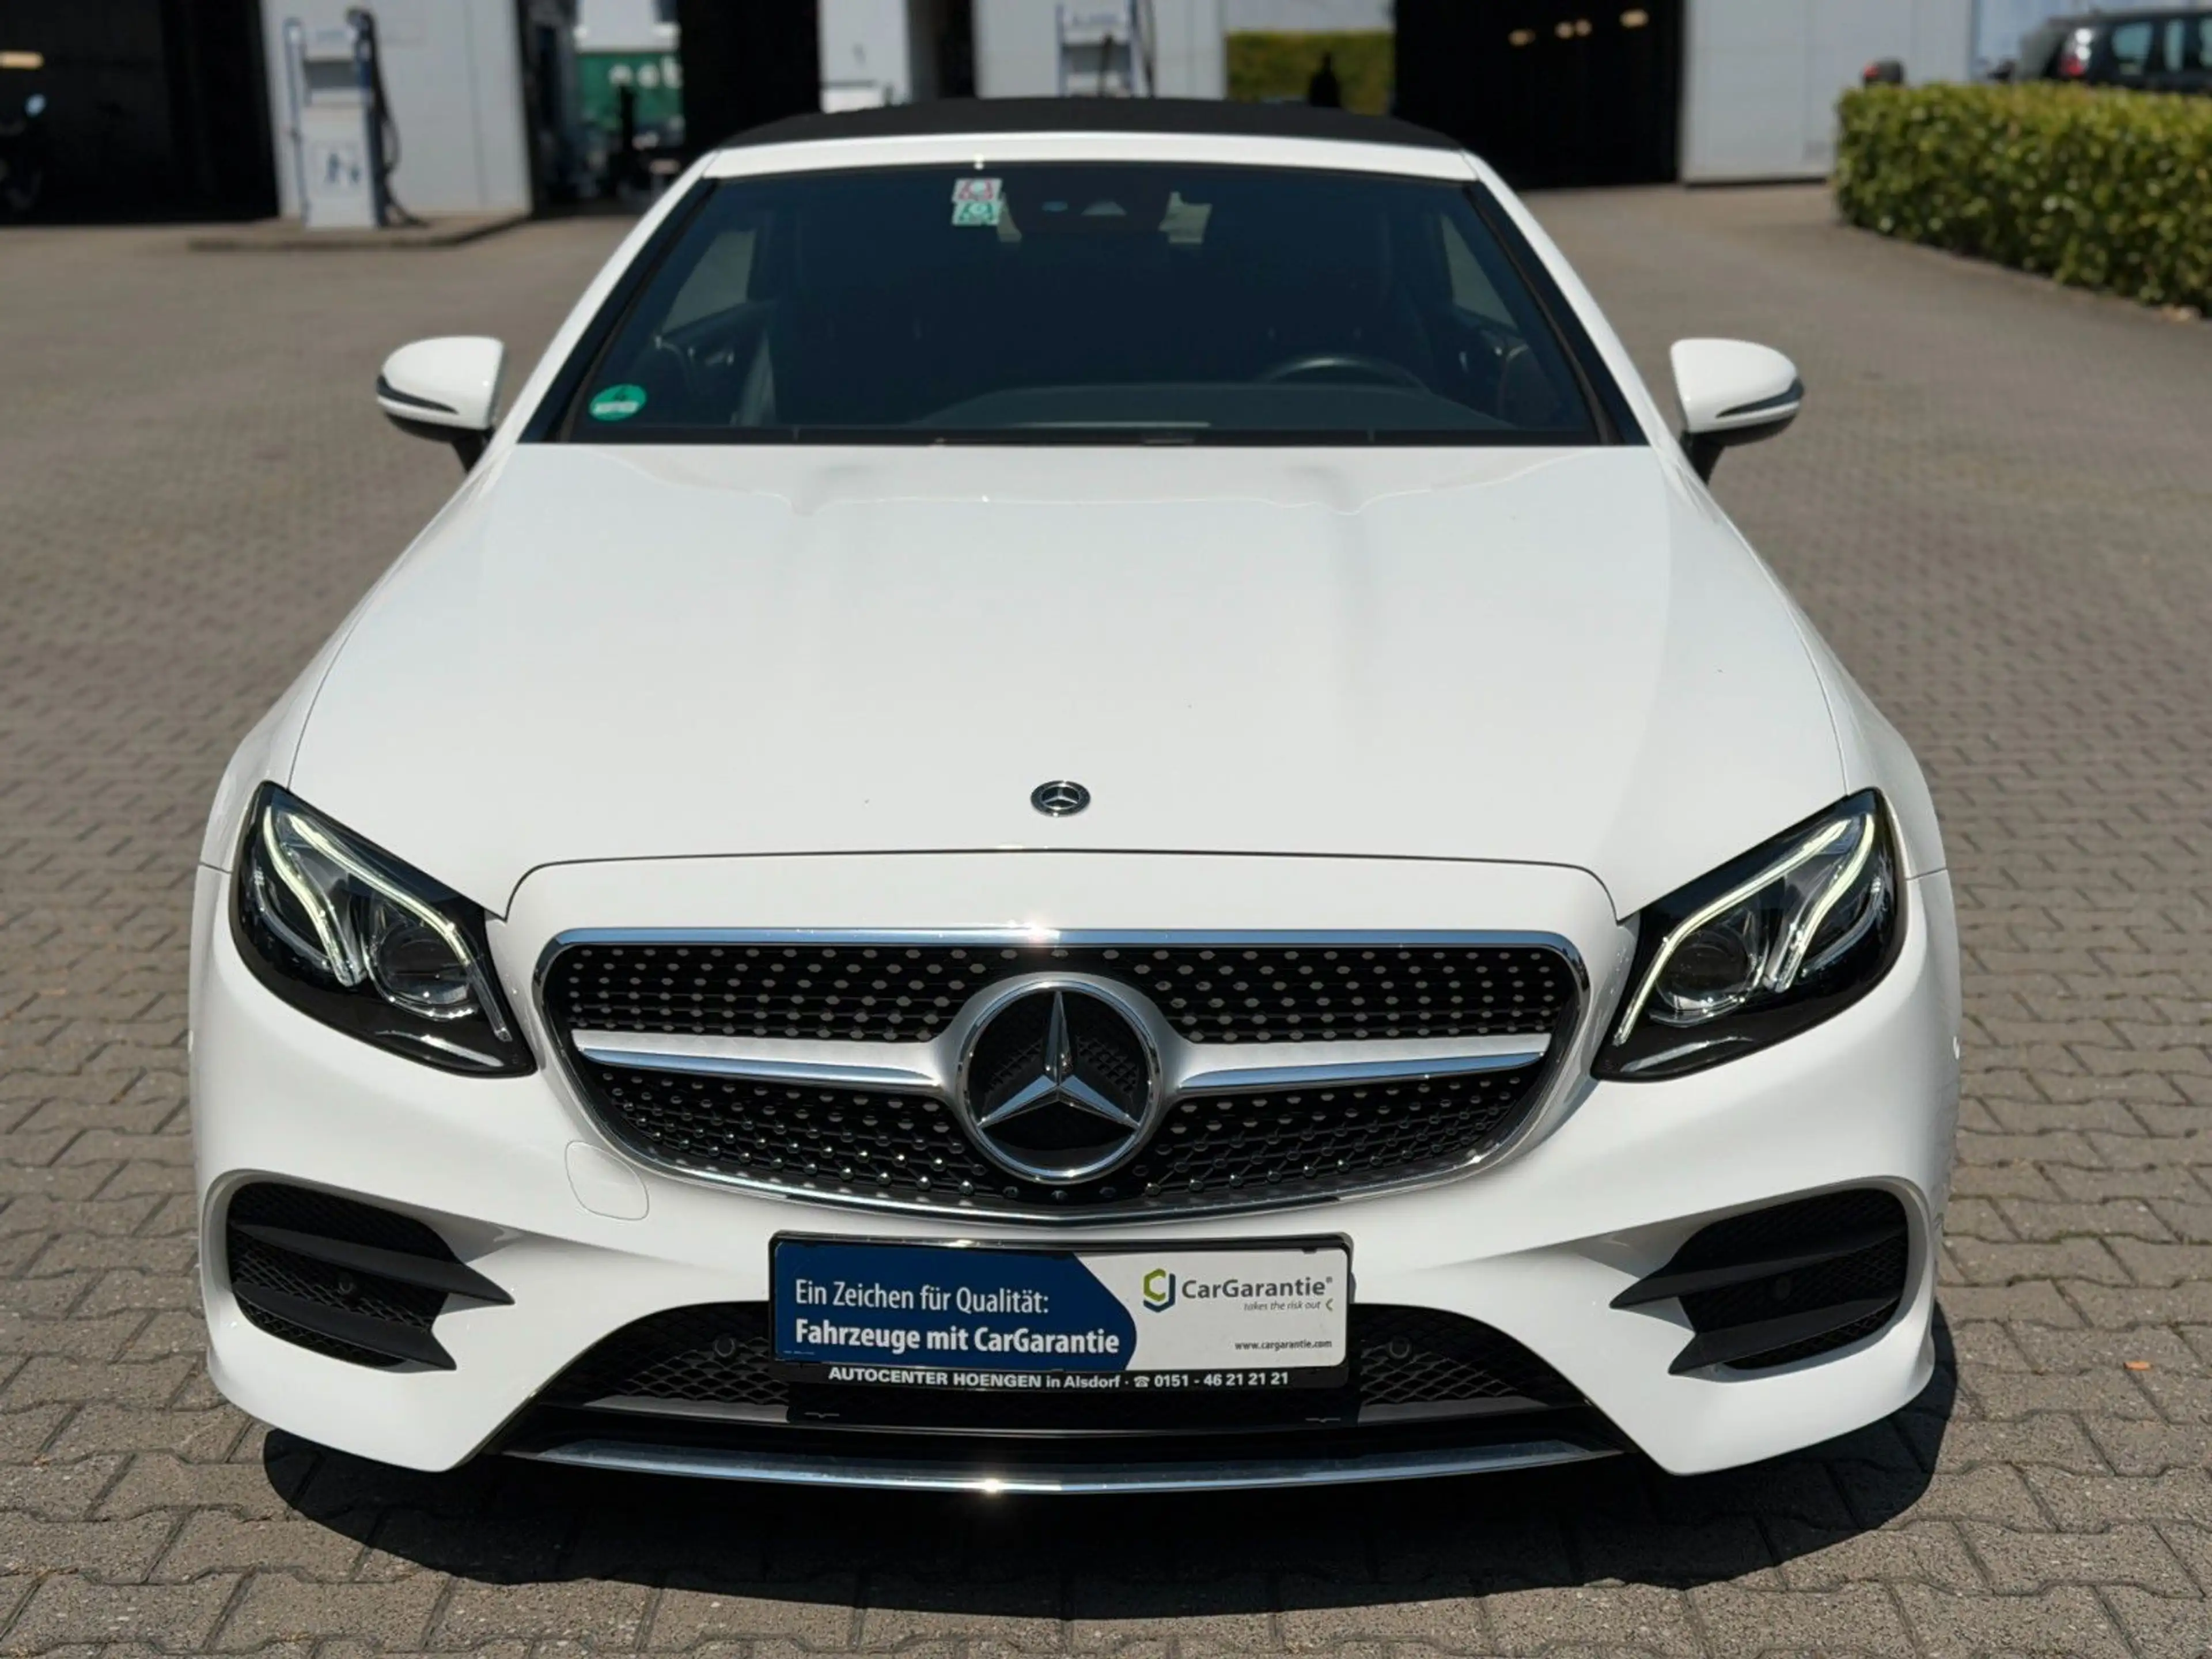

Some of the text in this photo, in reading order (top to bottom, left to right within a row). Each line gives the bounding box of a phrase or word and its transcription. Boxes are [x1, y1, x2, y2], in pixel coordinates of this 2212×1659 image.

[796, 1278, 1049, 1315] Ein Zeichen für Qualität:
[1270, 1300, 1285, 1310] the
[1287, 1301, 1302, 1309] risk
[1305, 1301, 1321, 1309] out
[796, 1318, 1119, 1354] Fahrzeuge mit CarGarantie
[1234, 1339, 1332, 1352] www.cargarantie.com
[828, 1367, 949, 1385] AUTOCENTER
[953, 1373, 1041, 1388] HOENGEN
[1046, 1375, 1061, 1388] in
[1063, 1374, 1121, 1388] Alsdorf
[1154, 1374, 1188, 1388] 0151
[1203, 1373, 1222, 1387] 46
[1226, 1373, 1243, 1386] 21
[1248, 1372, 1266, 1385] 21
[1270, 1372, 1288, 1385] 21
